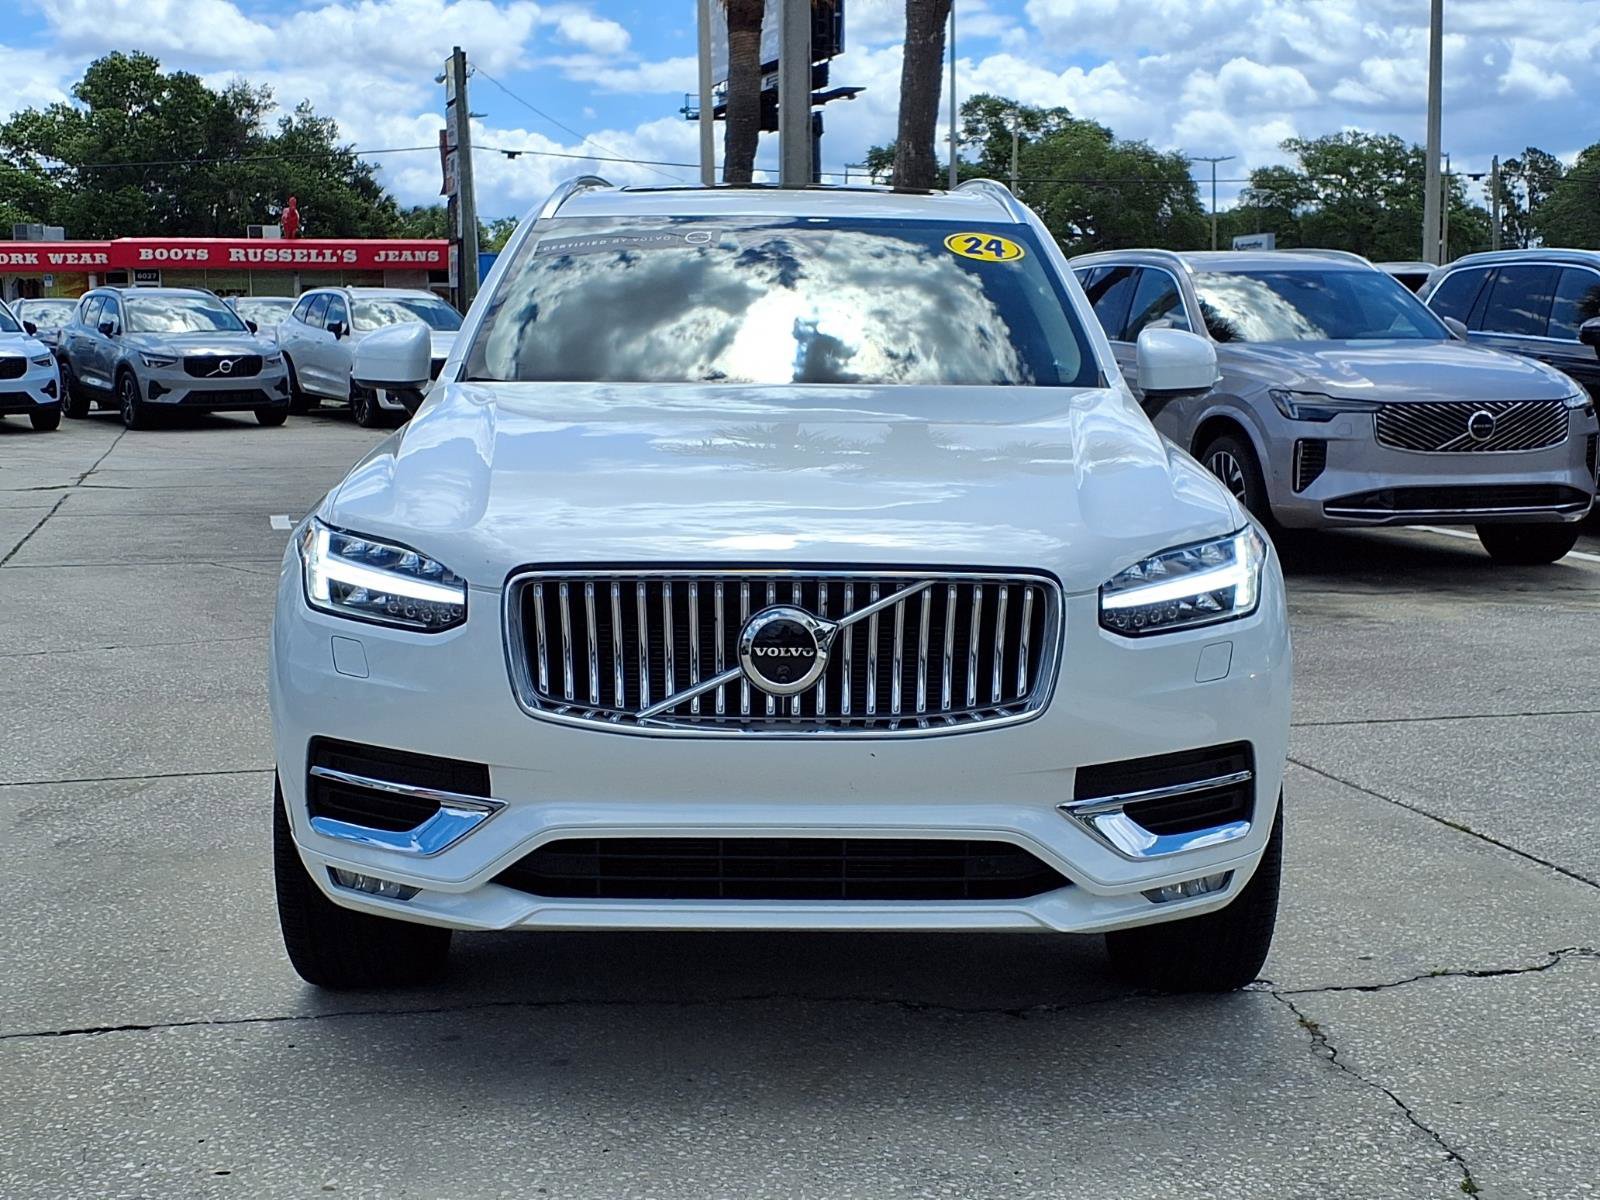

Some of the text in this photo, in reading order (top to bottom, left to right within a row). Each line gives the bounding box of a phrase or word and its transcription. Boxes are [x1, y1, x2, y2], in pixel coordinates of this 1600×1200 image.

[543, 239, 607, 251] CERTIFIED
[963, 236, 1006, 258] 24
[47, 253, 109, 265] WEAR
[138, 248, 440, 263] BOOTS RUSSELL'S JEANS
[754, 647, 814, 657] VOLVO
